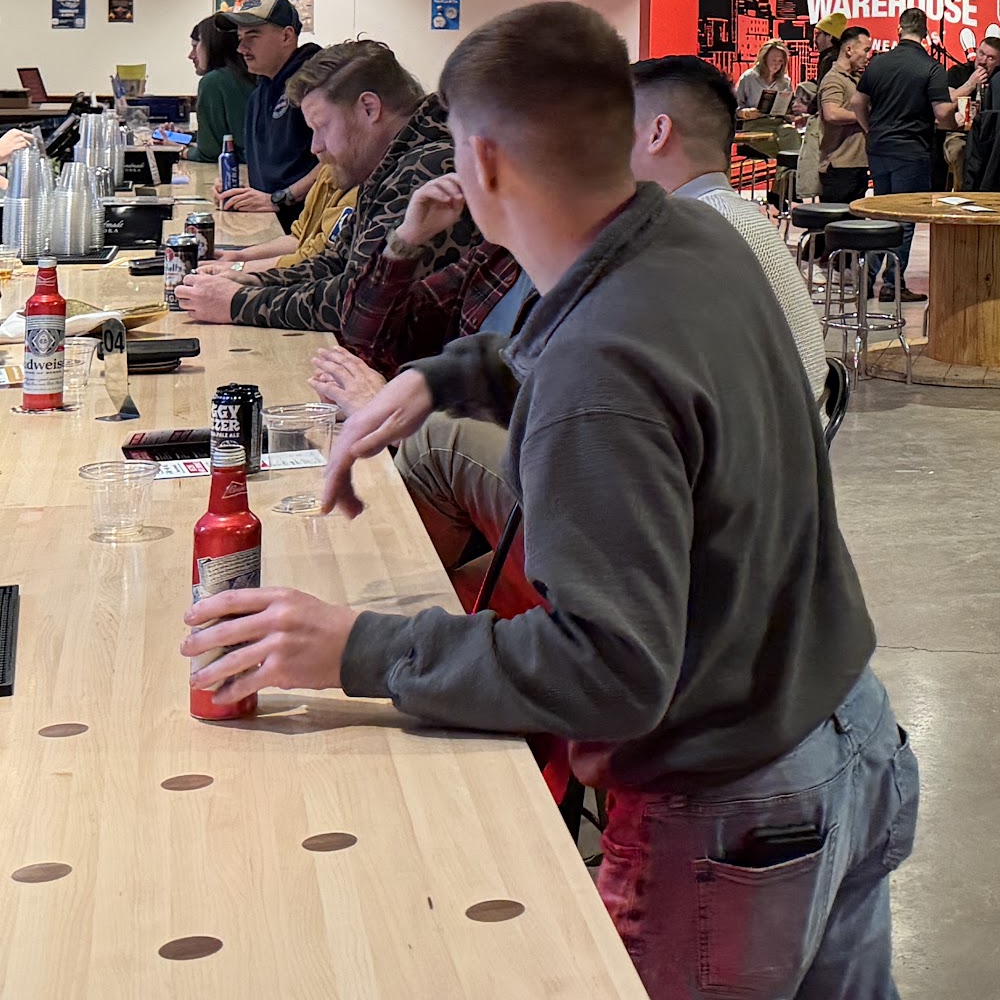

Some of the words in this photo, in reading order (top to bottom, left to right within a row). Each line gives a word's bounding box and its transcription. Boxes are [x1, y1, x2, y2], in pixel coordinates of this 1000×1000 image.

[103, 329, 125, 354] 04
[25, 359, 64, 370] dweis
[211, 403, 241, 419] GGY
[211, 419, 241, 432] ZER
